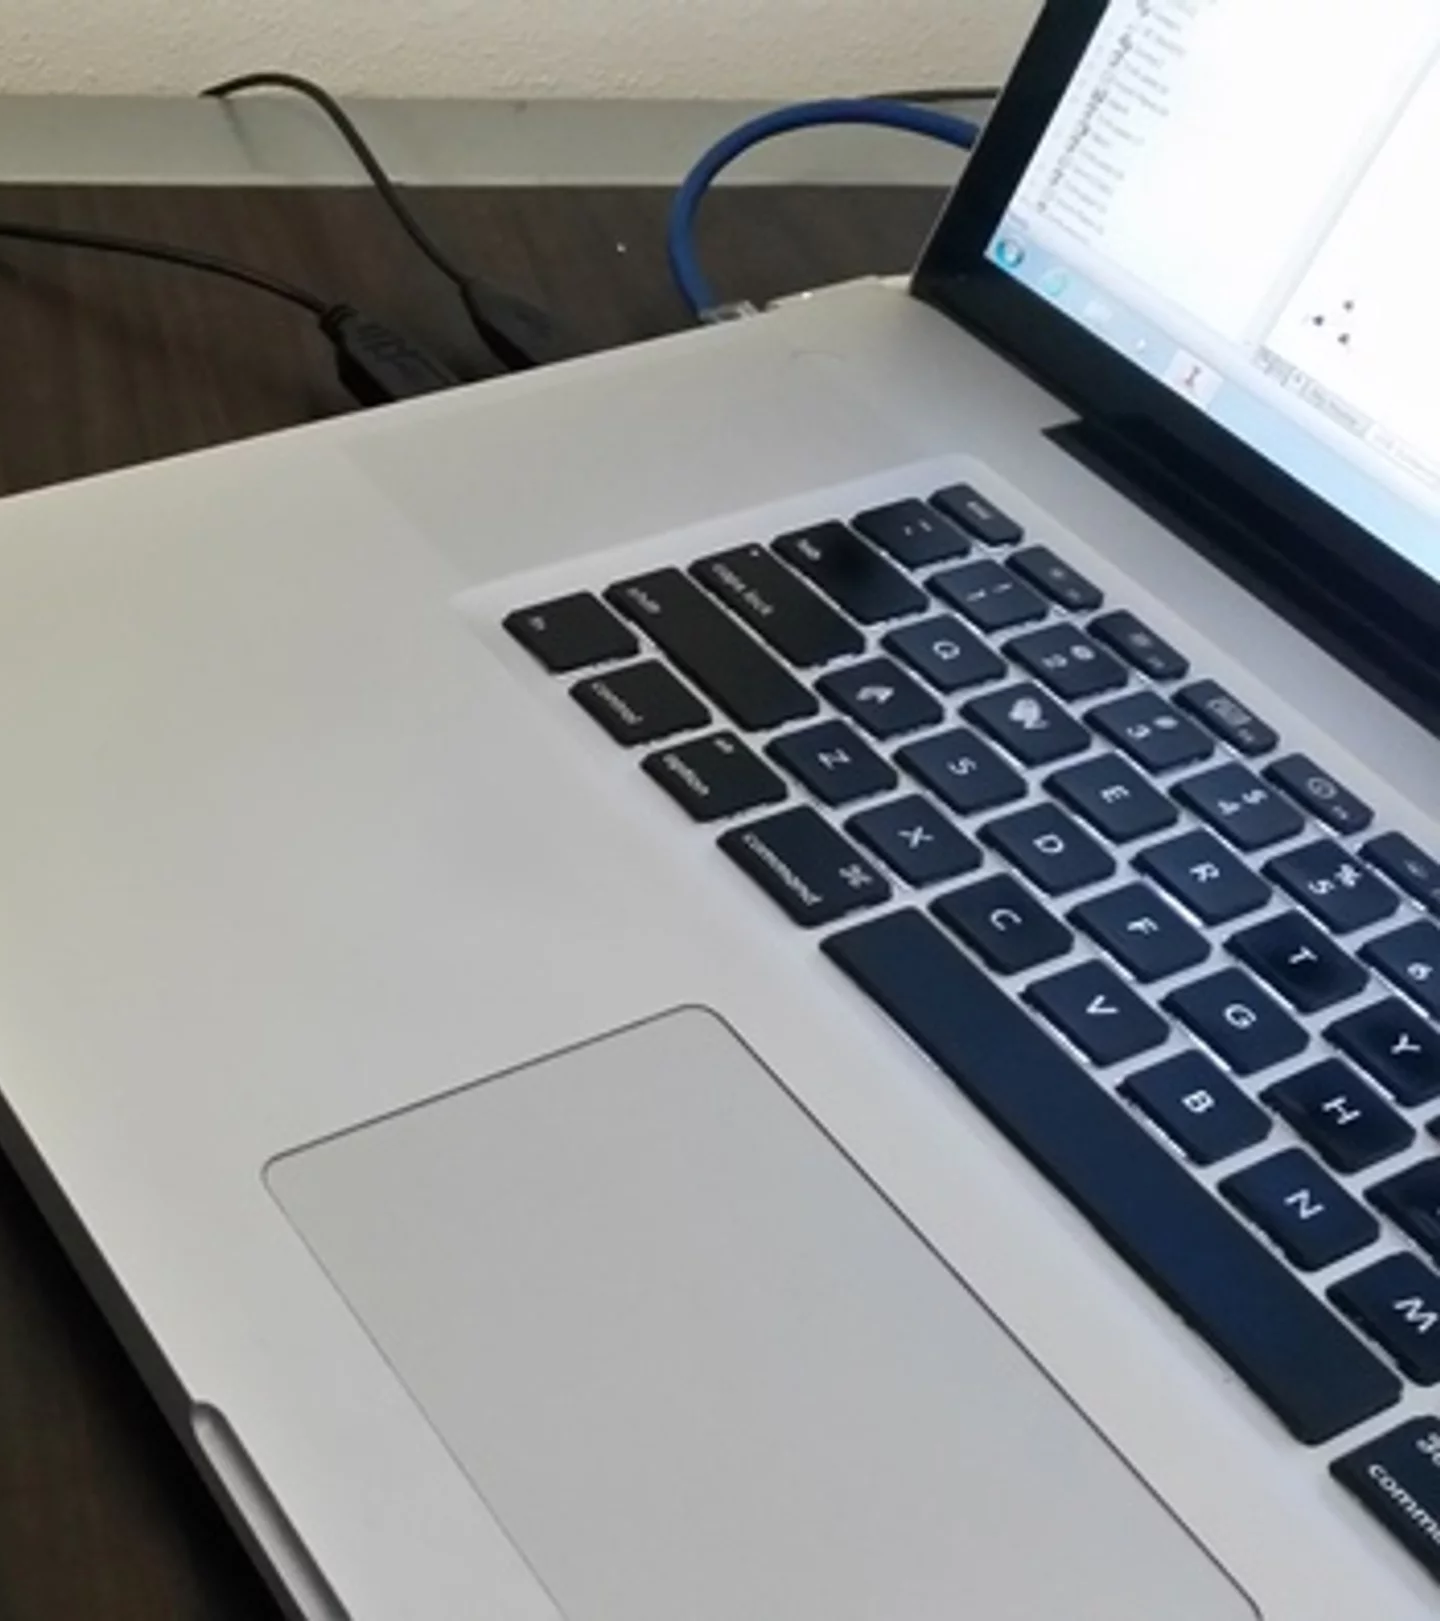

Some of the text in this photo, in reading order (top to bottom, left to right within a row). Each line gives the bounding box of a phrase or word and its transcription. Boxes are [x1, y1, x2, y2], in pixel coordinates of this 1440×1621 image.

[932, 640, 961, 661] Q
[592, 681, 644, 725] control
[856, 686, 894, 703] A
[1126, 724, 1151, 740] 3
[817, 748, 851, 769] Z
[947, 757, 977, 776] S
[662, 754, 709, 796] option
[1100, 785, 1130, 804] E
[898, 825, 933, 848] X
[1033, 833, 1065, 854] D
[742, 832, 822, 905] command
[1189, 862, 1220, 883] R
[1306, 878, 1334, 896] 5
[989, 908, 1023, 931] C
[1127, 917, 1158, 934] F
[1289, 945, 1318, 964] T
[1407, 962, 1433, 981] 6
[1085, 994, 1119, 1015] V
[1223, 1003, 1257, 1029] G
[1391, 1033, 1421, 1054] Y
[1181, 1089, 1215, 1114] B
[1322, 1096, 1361, 1125] H
[1284, 1189, 1325, 1220] N
[1393, 1297, 1439, 1333] M
